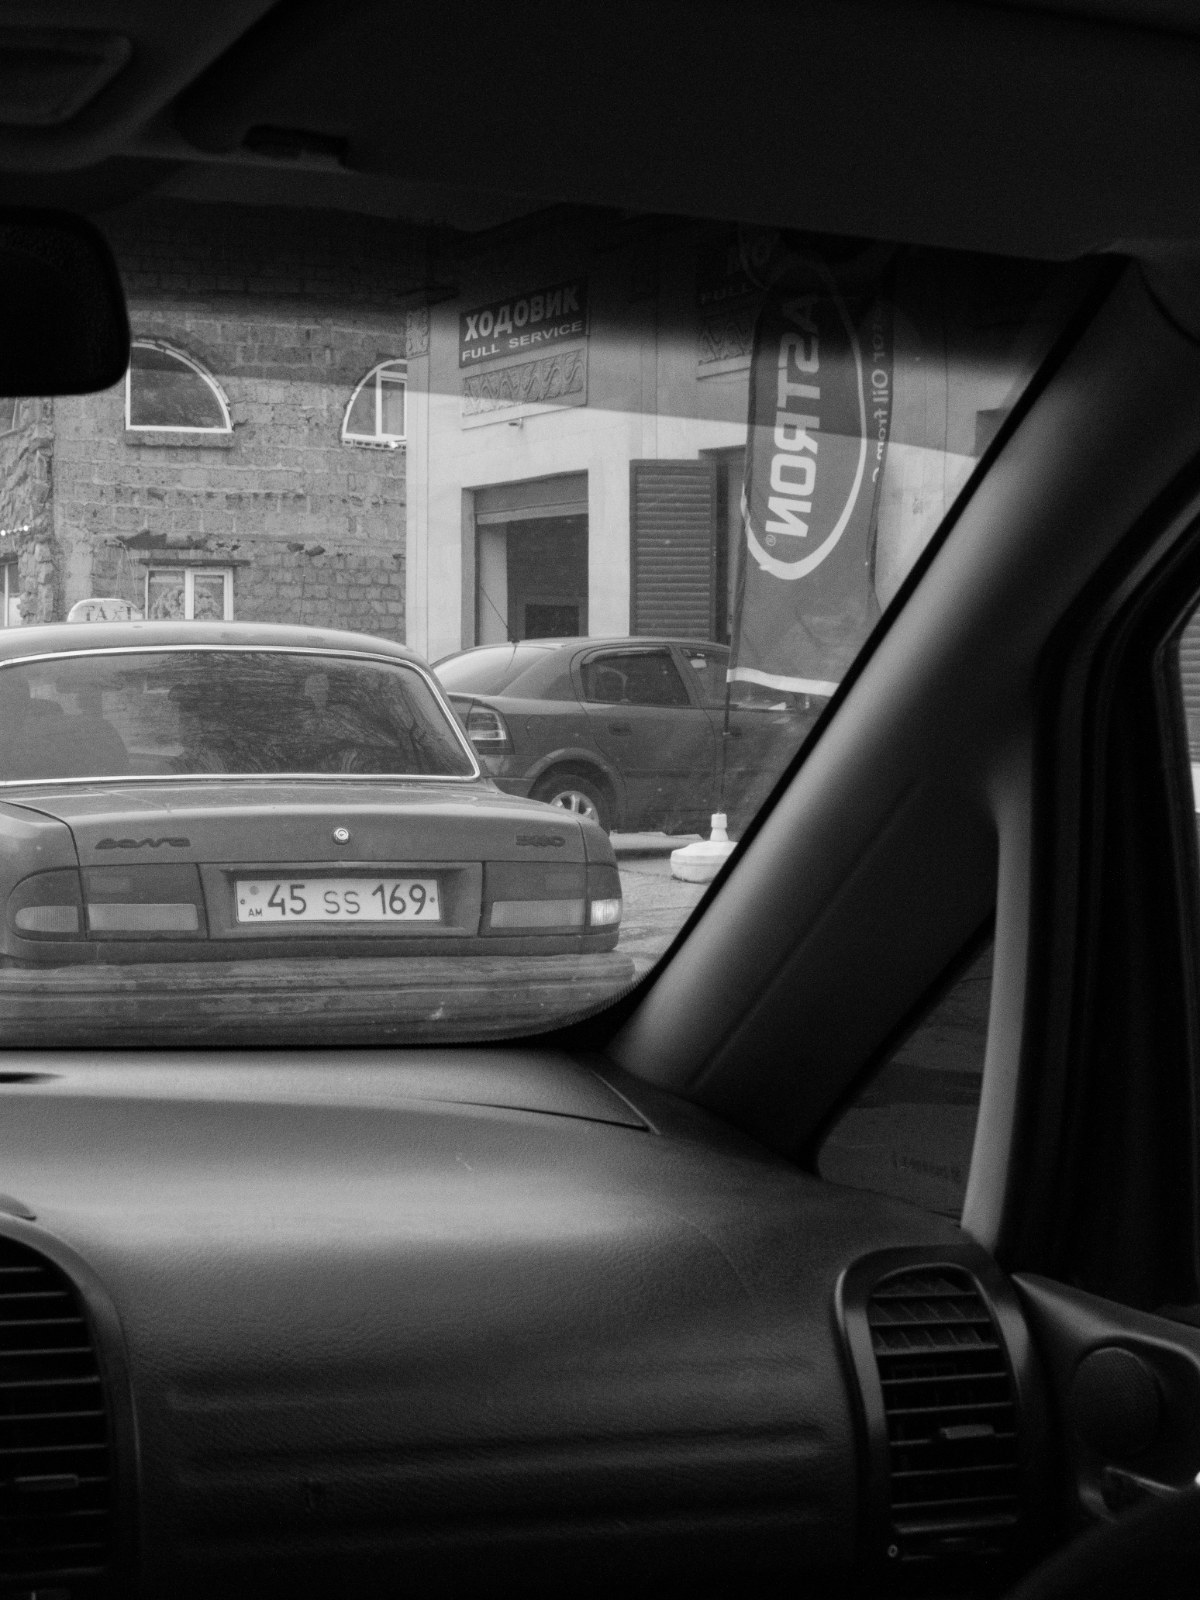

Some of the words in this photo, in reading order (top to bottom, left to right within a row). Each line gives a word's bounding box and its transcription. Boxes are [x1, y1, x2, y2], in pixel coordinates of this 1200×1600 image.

[464, 285, 580, 342] ХОДОВИК
[461, 343, 501, 362] FULL
[508, 320, 583, 349] SERVICE
[248, 908, 263, 917] AM
[267, 884, 307, 916] 45
[323, 890, 360, 914] SS
[371, 883, 427, 916] 169
